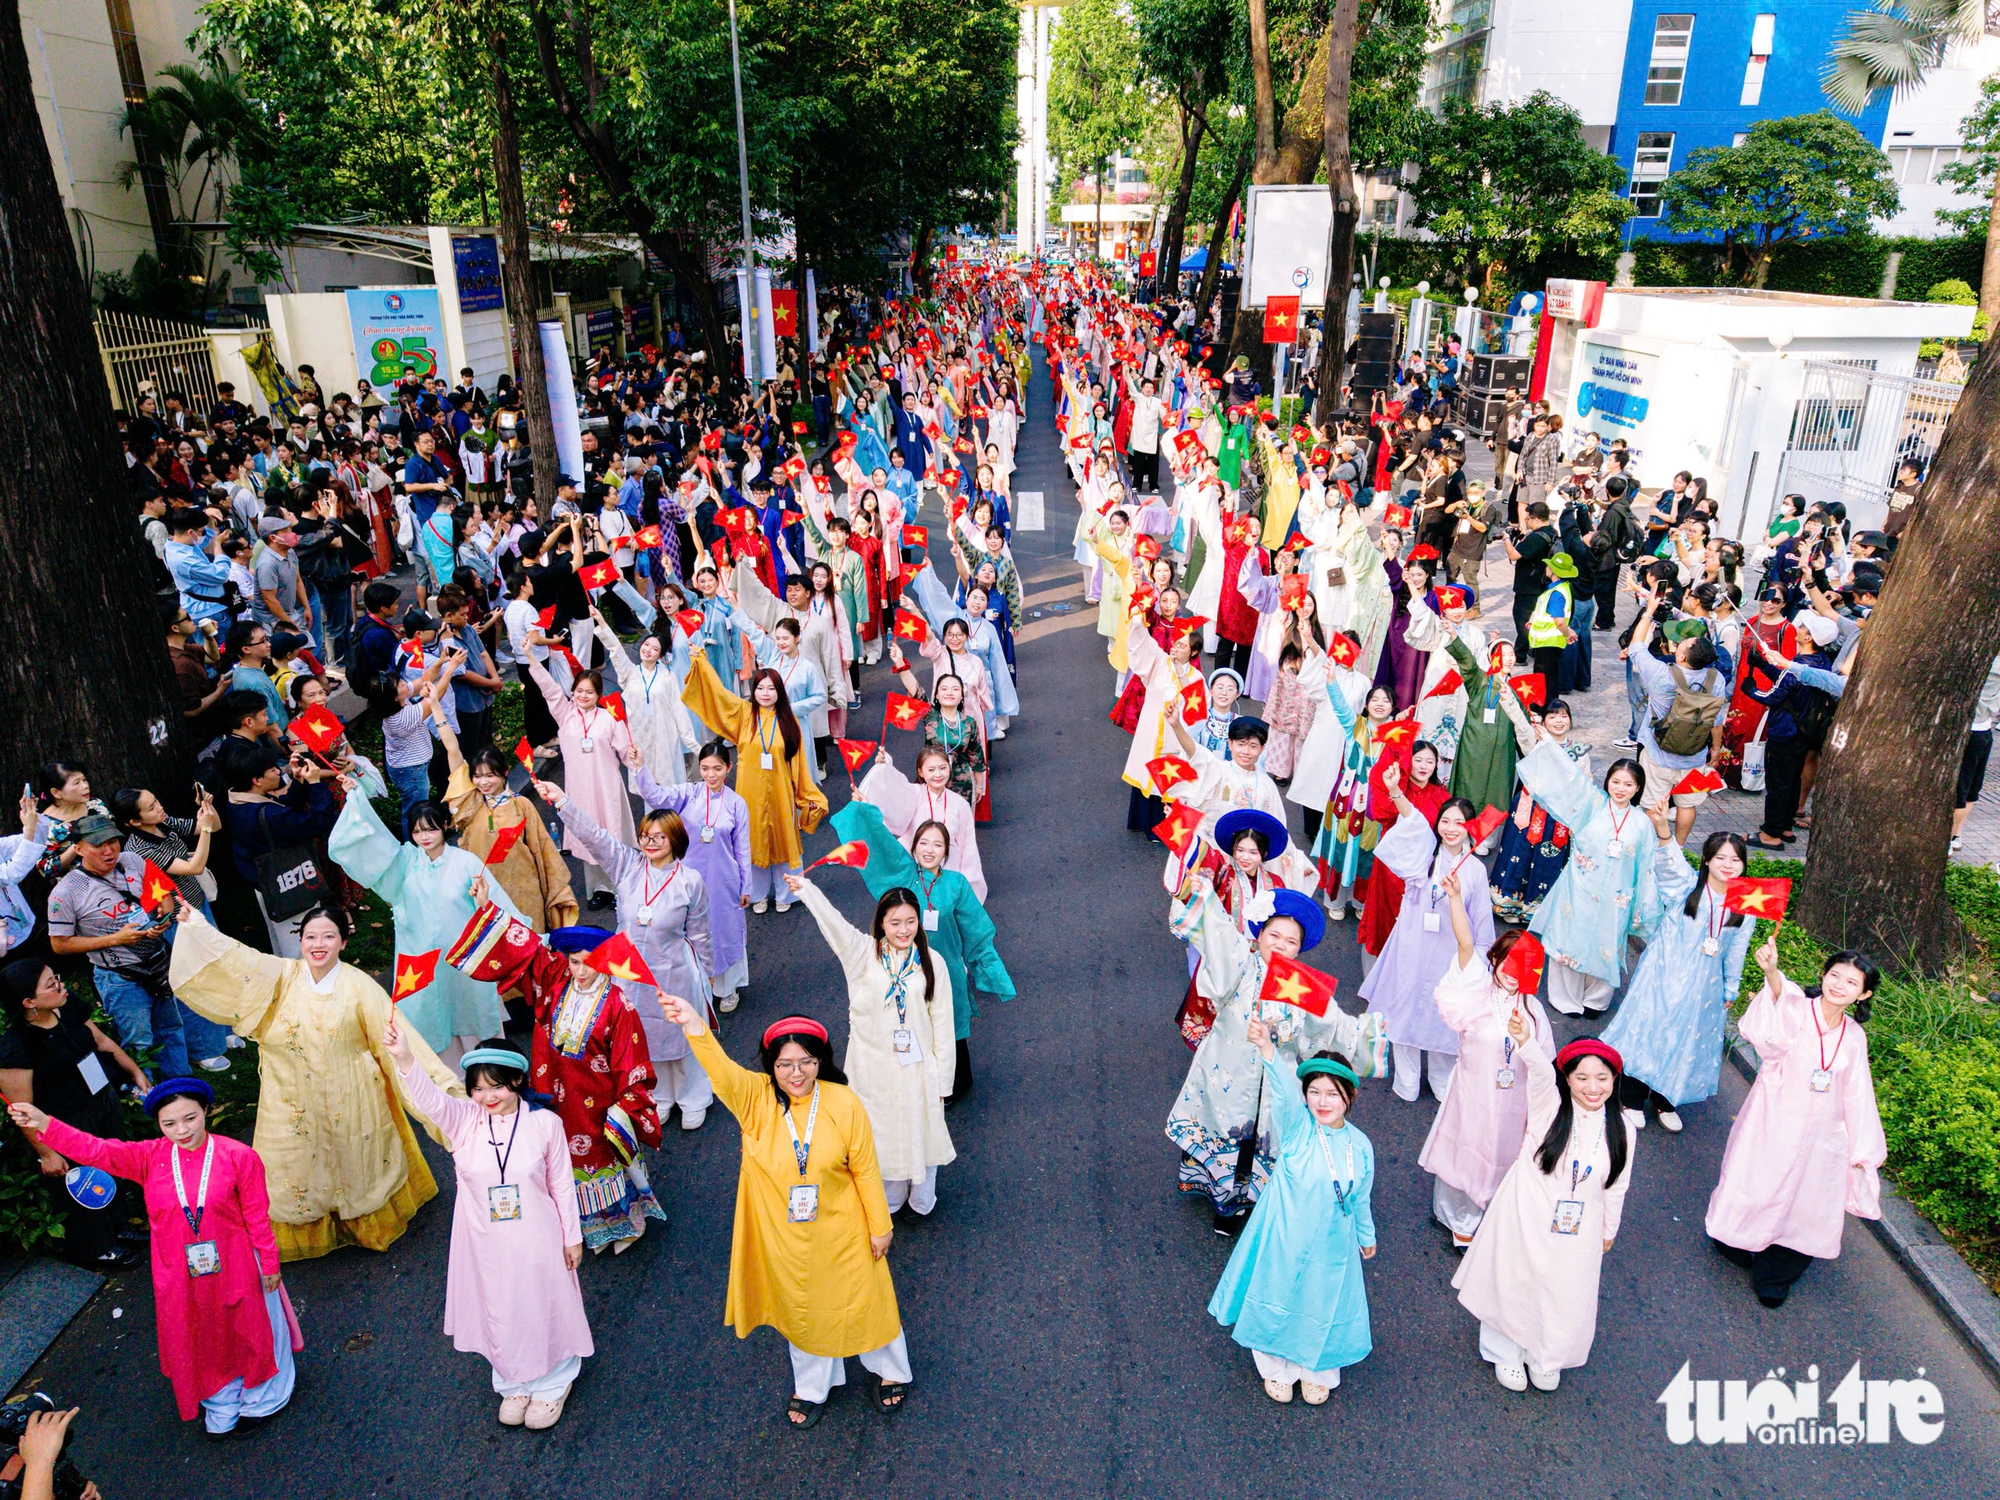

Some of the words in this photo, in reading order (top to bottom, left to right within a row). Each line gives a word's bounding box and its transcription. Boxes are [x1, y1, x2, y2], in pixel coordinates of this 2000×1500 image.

[362, 325, 381, 336] Chào
[383, 325, 404, 335] mừng
[416, 324, 434, 333] niệm
[370, 336, 437, 387] 85
[381, 365, 400, 374] 15.5
[1605, 356, 1615, 366] BAN
[1615, 358, 1627, 368] NHÂN
[1628, 360, 1638, 370] DÂN
[1592, 366, 1605, 377] THÀNH
[1605, 368, 1616, 380] PHỐ
[1615, 370, 1622, 381] HỒ
[1630, 376, 1642, 386] MINH
[149, 720, 168, 745] 22
[277, 860, 317, 893] 1876
